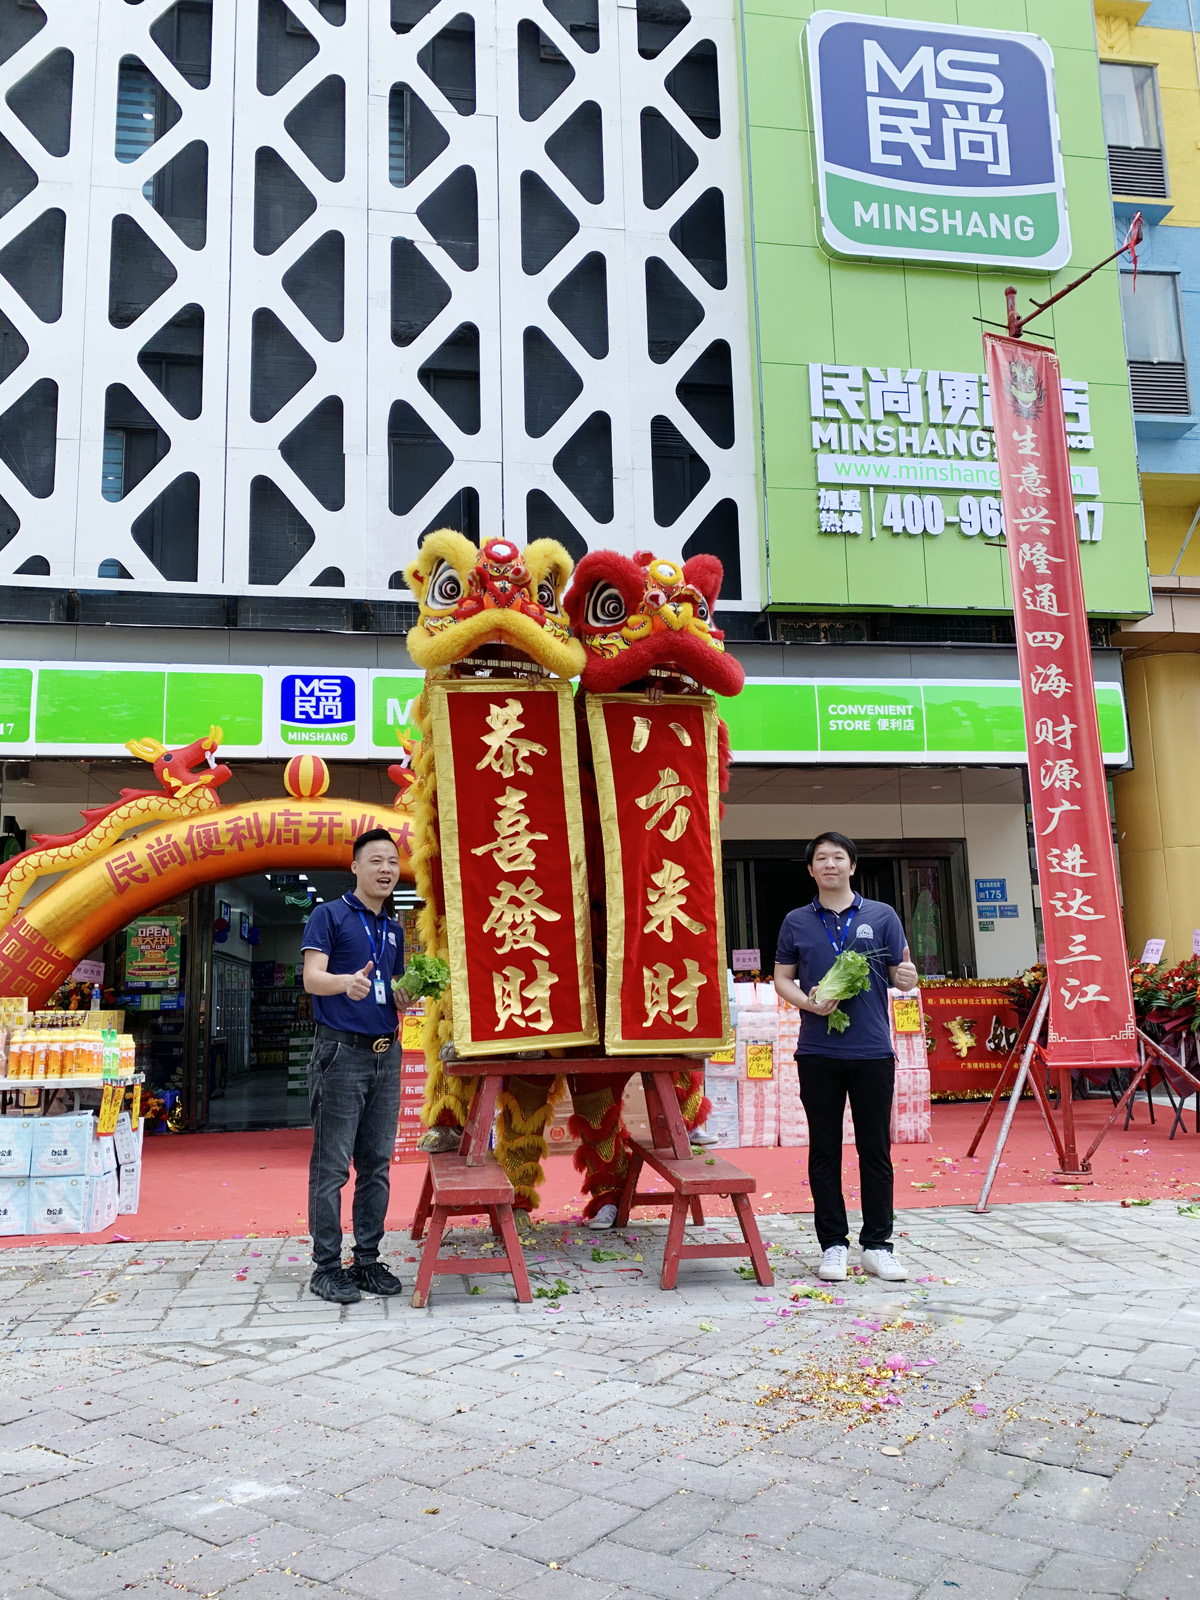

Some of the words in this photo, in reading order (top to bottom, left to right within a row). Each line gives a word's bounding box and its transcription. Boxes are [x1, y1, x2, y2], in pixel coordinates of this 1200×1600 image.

[863, 39, 1004, 105] MS
[867, 96, 1011, 176] 民尚
[853, 201, 1035, 241] MINSHANG
[811, 421, 992, 458] MINSHANG
[295, 678, 342, 697] MS
[294, 696, 342, 719] 民尚
[828, 704, 914, 716] CONVENIENT
[829, 720, 871, 731] STORE
[877, 718, 915, 731] 便利店
[288, 731, 348, 742] MINSHANG
[985, 890, 1002, 899] 175
[138, 928, 169, 937] OPEN
[75, 967, 102, 977] 开业大吉
